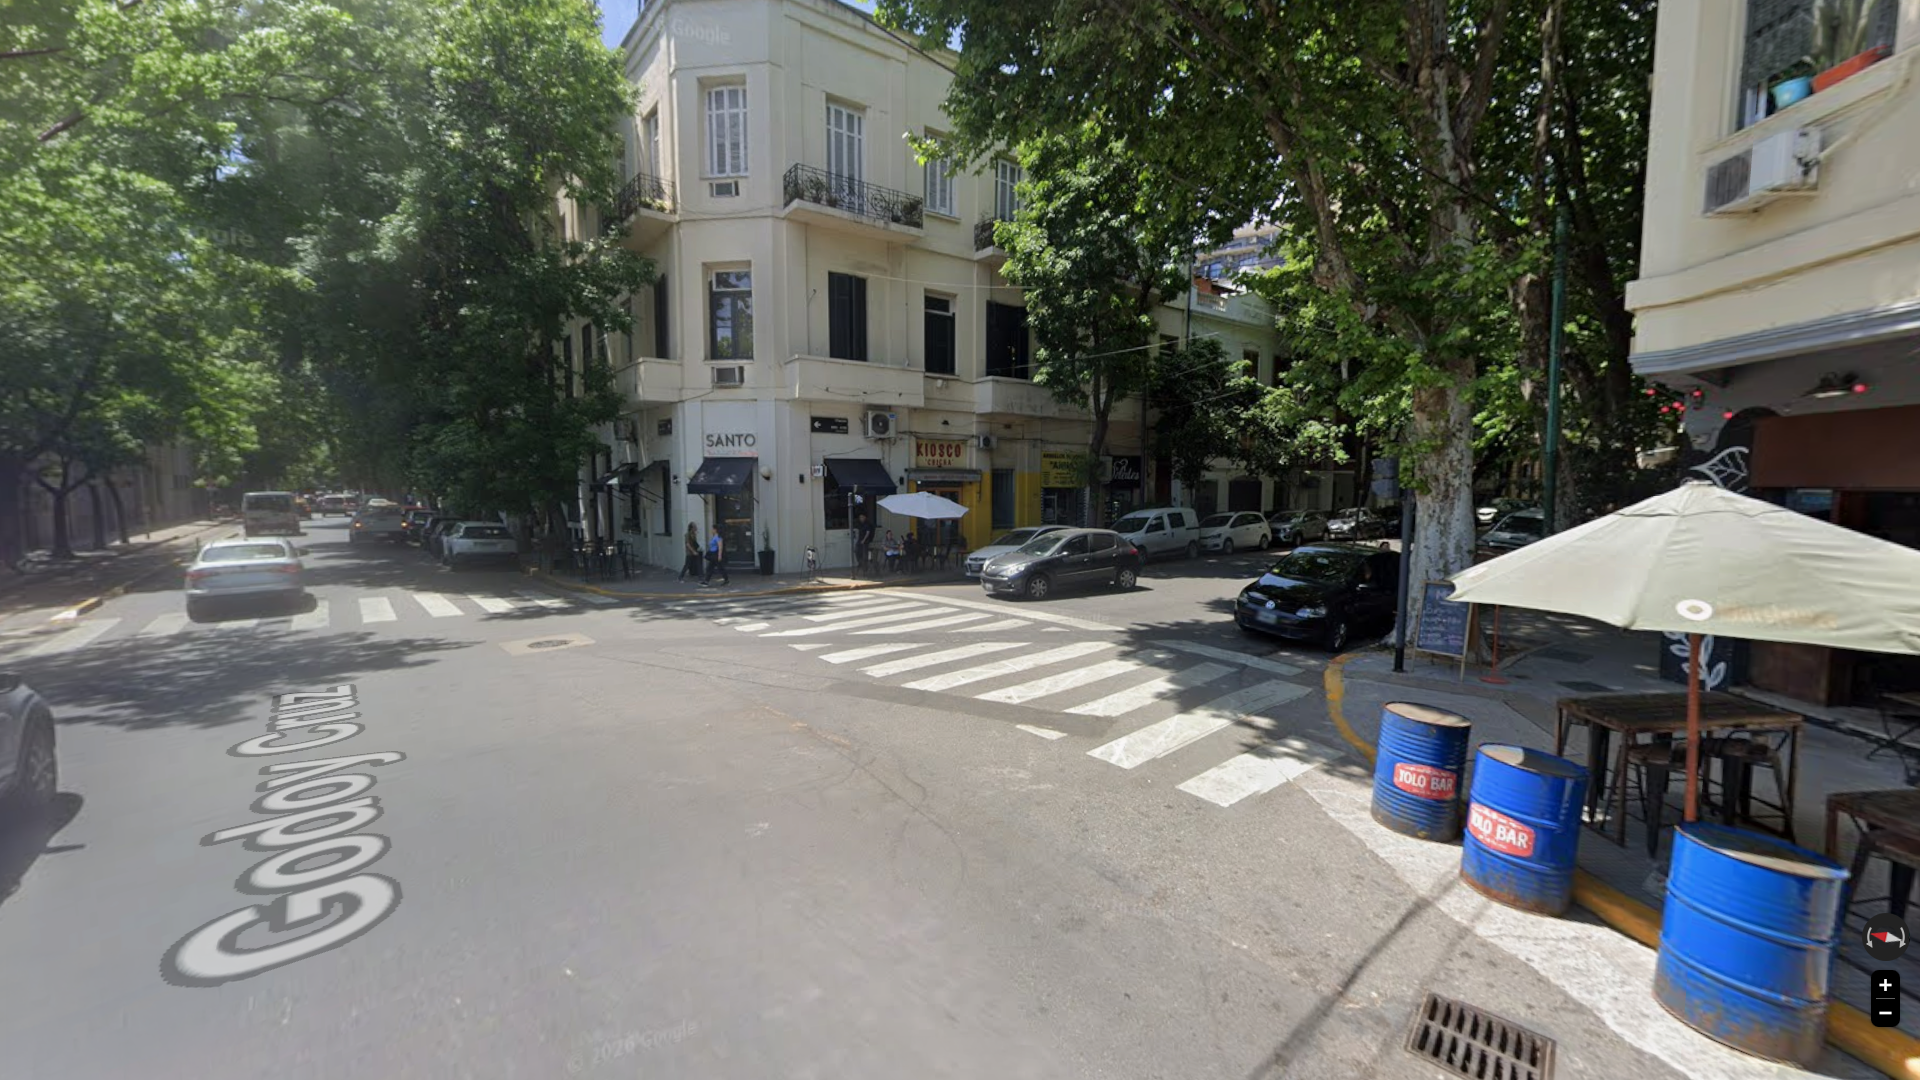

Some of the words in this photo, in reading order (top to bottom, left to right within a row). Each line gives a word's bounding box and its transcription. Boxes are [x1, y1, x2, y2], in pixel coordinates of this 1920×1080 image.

[706, 433, 756, 447] SANTO
[916, 442, 961, 457] KIOSCO
[1431, 777, 1454, 791] BAR
[1496, 824, 1529, 849] BAR
